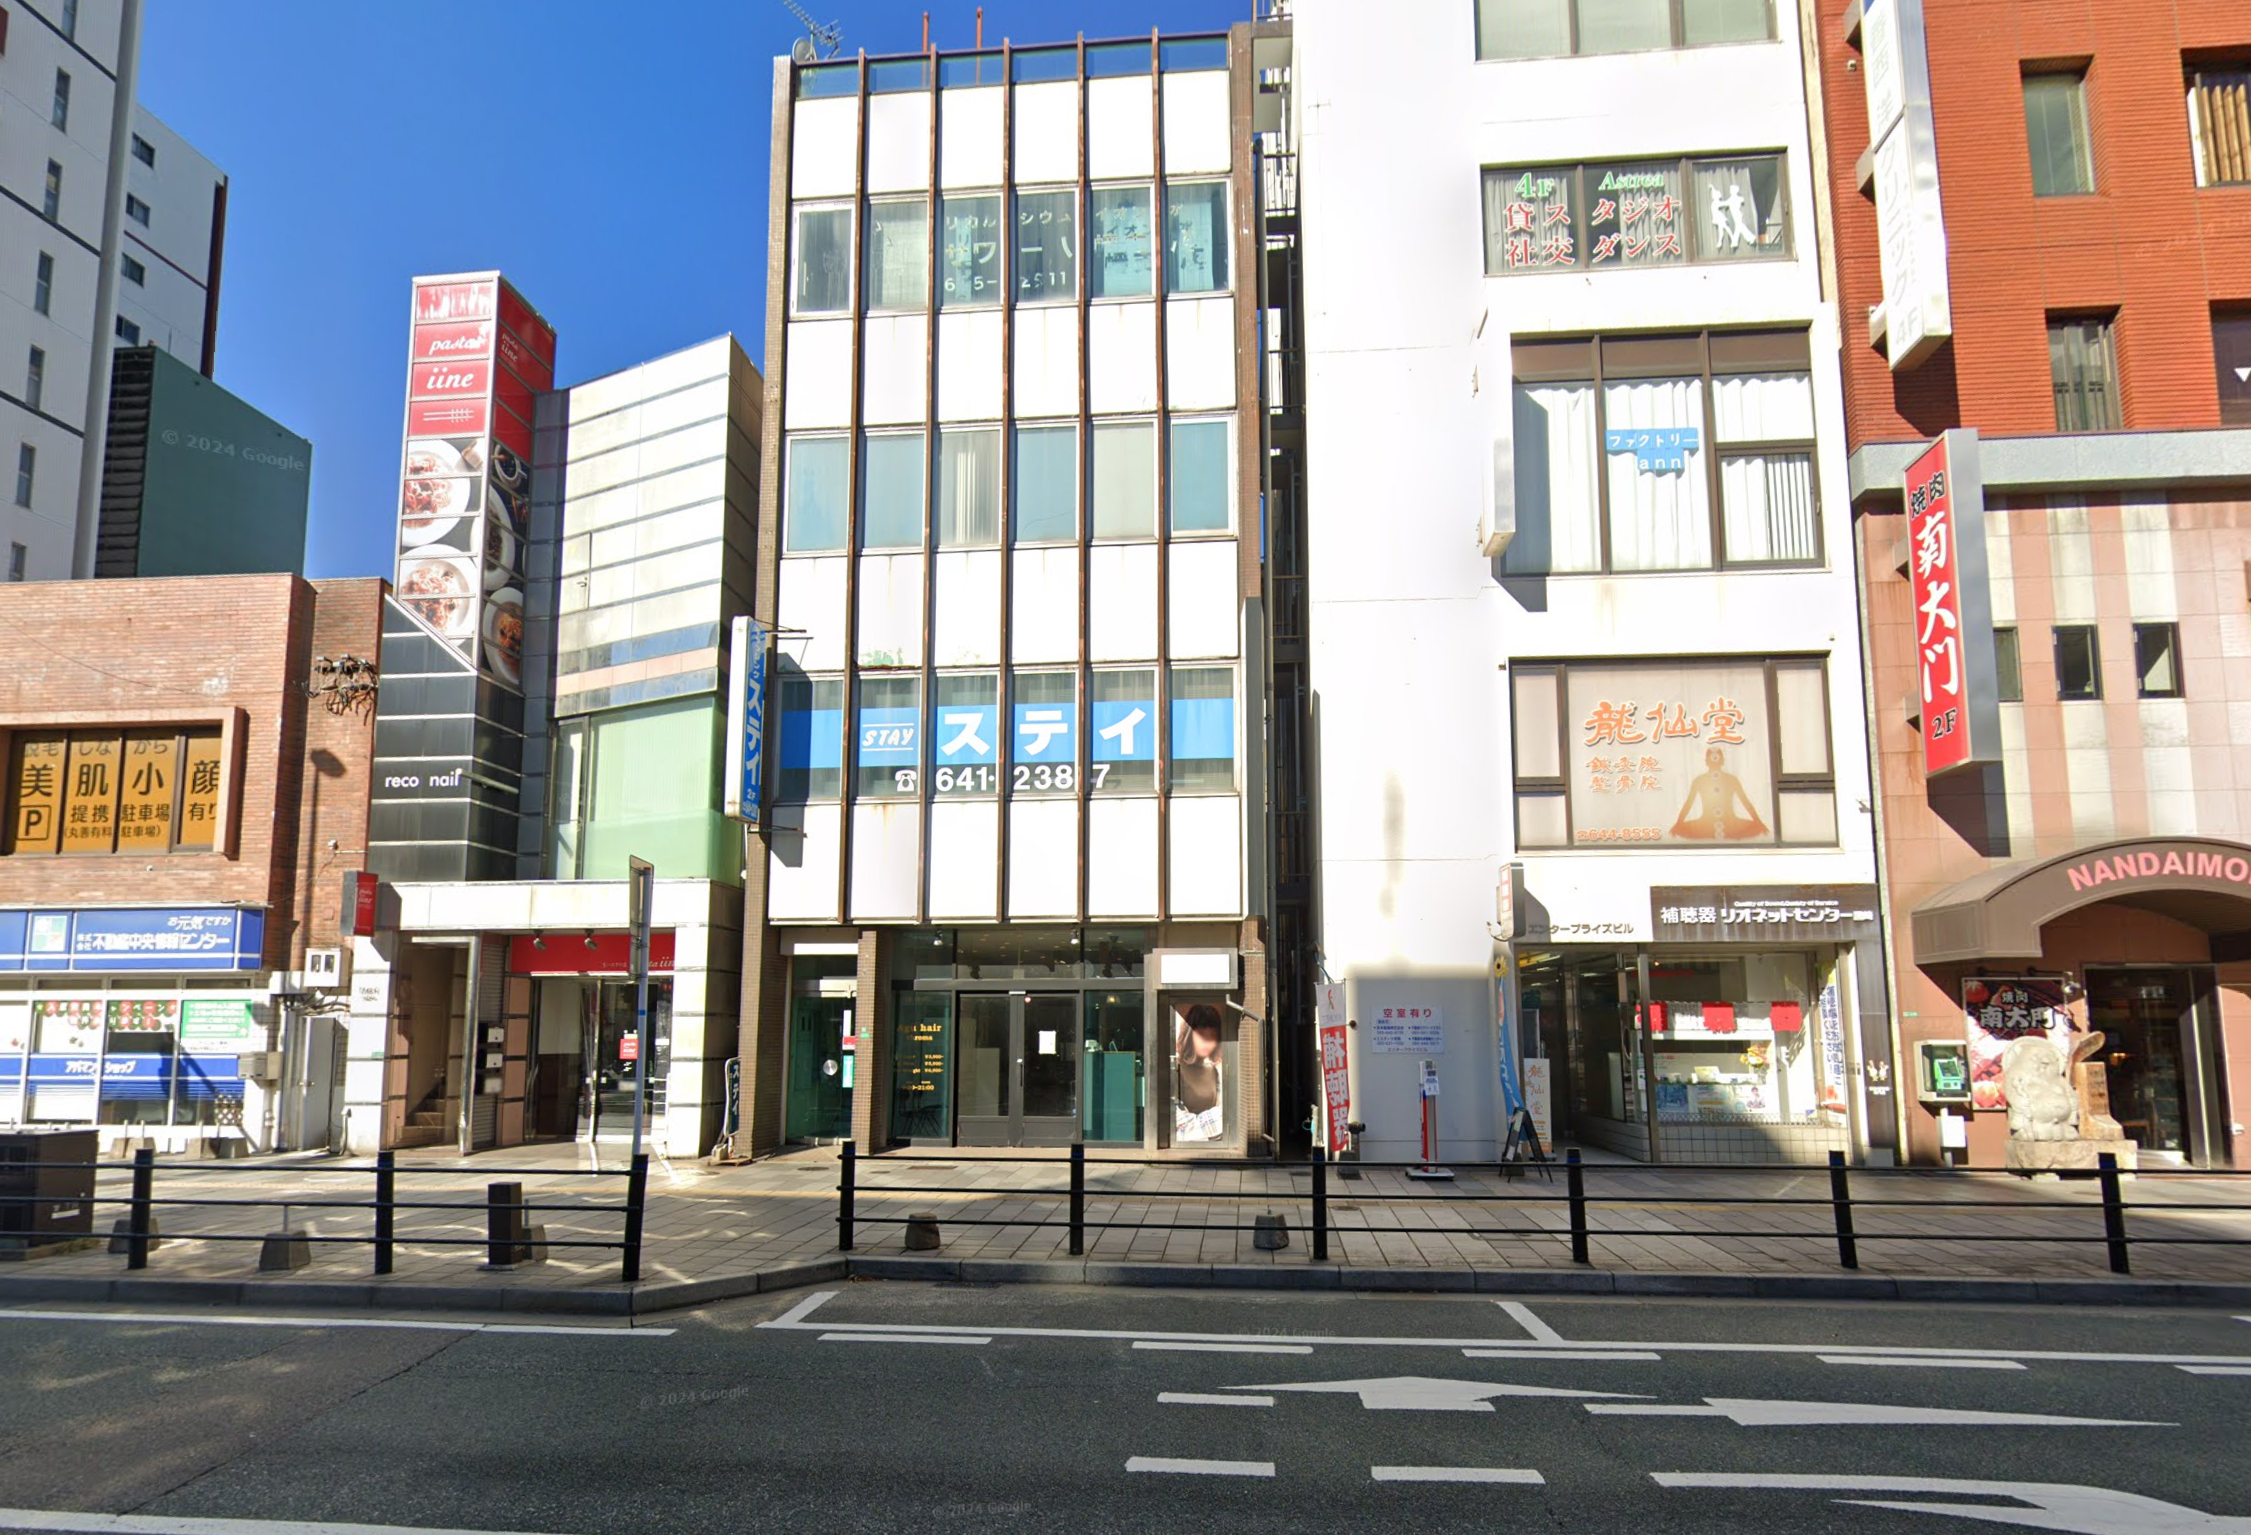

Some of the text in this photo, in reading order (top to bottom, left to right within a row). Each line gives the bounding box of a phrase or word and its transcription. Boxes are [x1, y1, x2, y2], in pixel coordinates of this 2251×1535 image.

[1514, 172, 1554, 198] 4F
[1598, 171, 1664, 191] Astrea
[429, 336, 478, 355] pasta
[427, 367, 474, 389] iine
[1609, 432, 1698, 448] ファクトリー
[1910, 471, 1945, 519] 焼肉
[1584, 697, 1745, 745] 龍仙堂
[1932, 709, 1957, 740] 2F
[746, 677, 764, 786] ステイ
[862, 726, 914, 747] STAY
[941, 707, 1146, 757] ステイ
[1587, 756, 1663, 773] 鍼灸院
[385, 769, 462, 788] reco nail
[1589, 827, 1661, 841] 644-8555
[2067, 852, 2251, 891] NANDAIMO
[167, 916, 232, 931] お元気ですか
[1660, 907, 1717, 924] 補聴器
[1528, 923, 1634, 936] エンタープライズビル
[2002, 991, 2029, 1003] 焼肉
[1383, 1008, 1432, 1018] 空室有り
[1980, 1005, 2055, 1029] 南大門
[920, 1024, 942, 1032] hair
